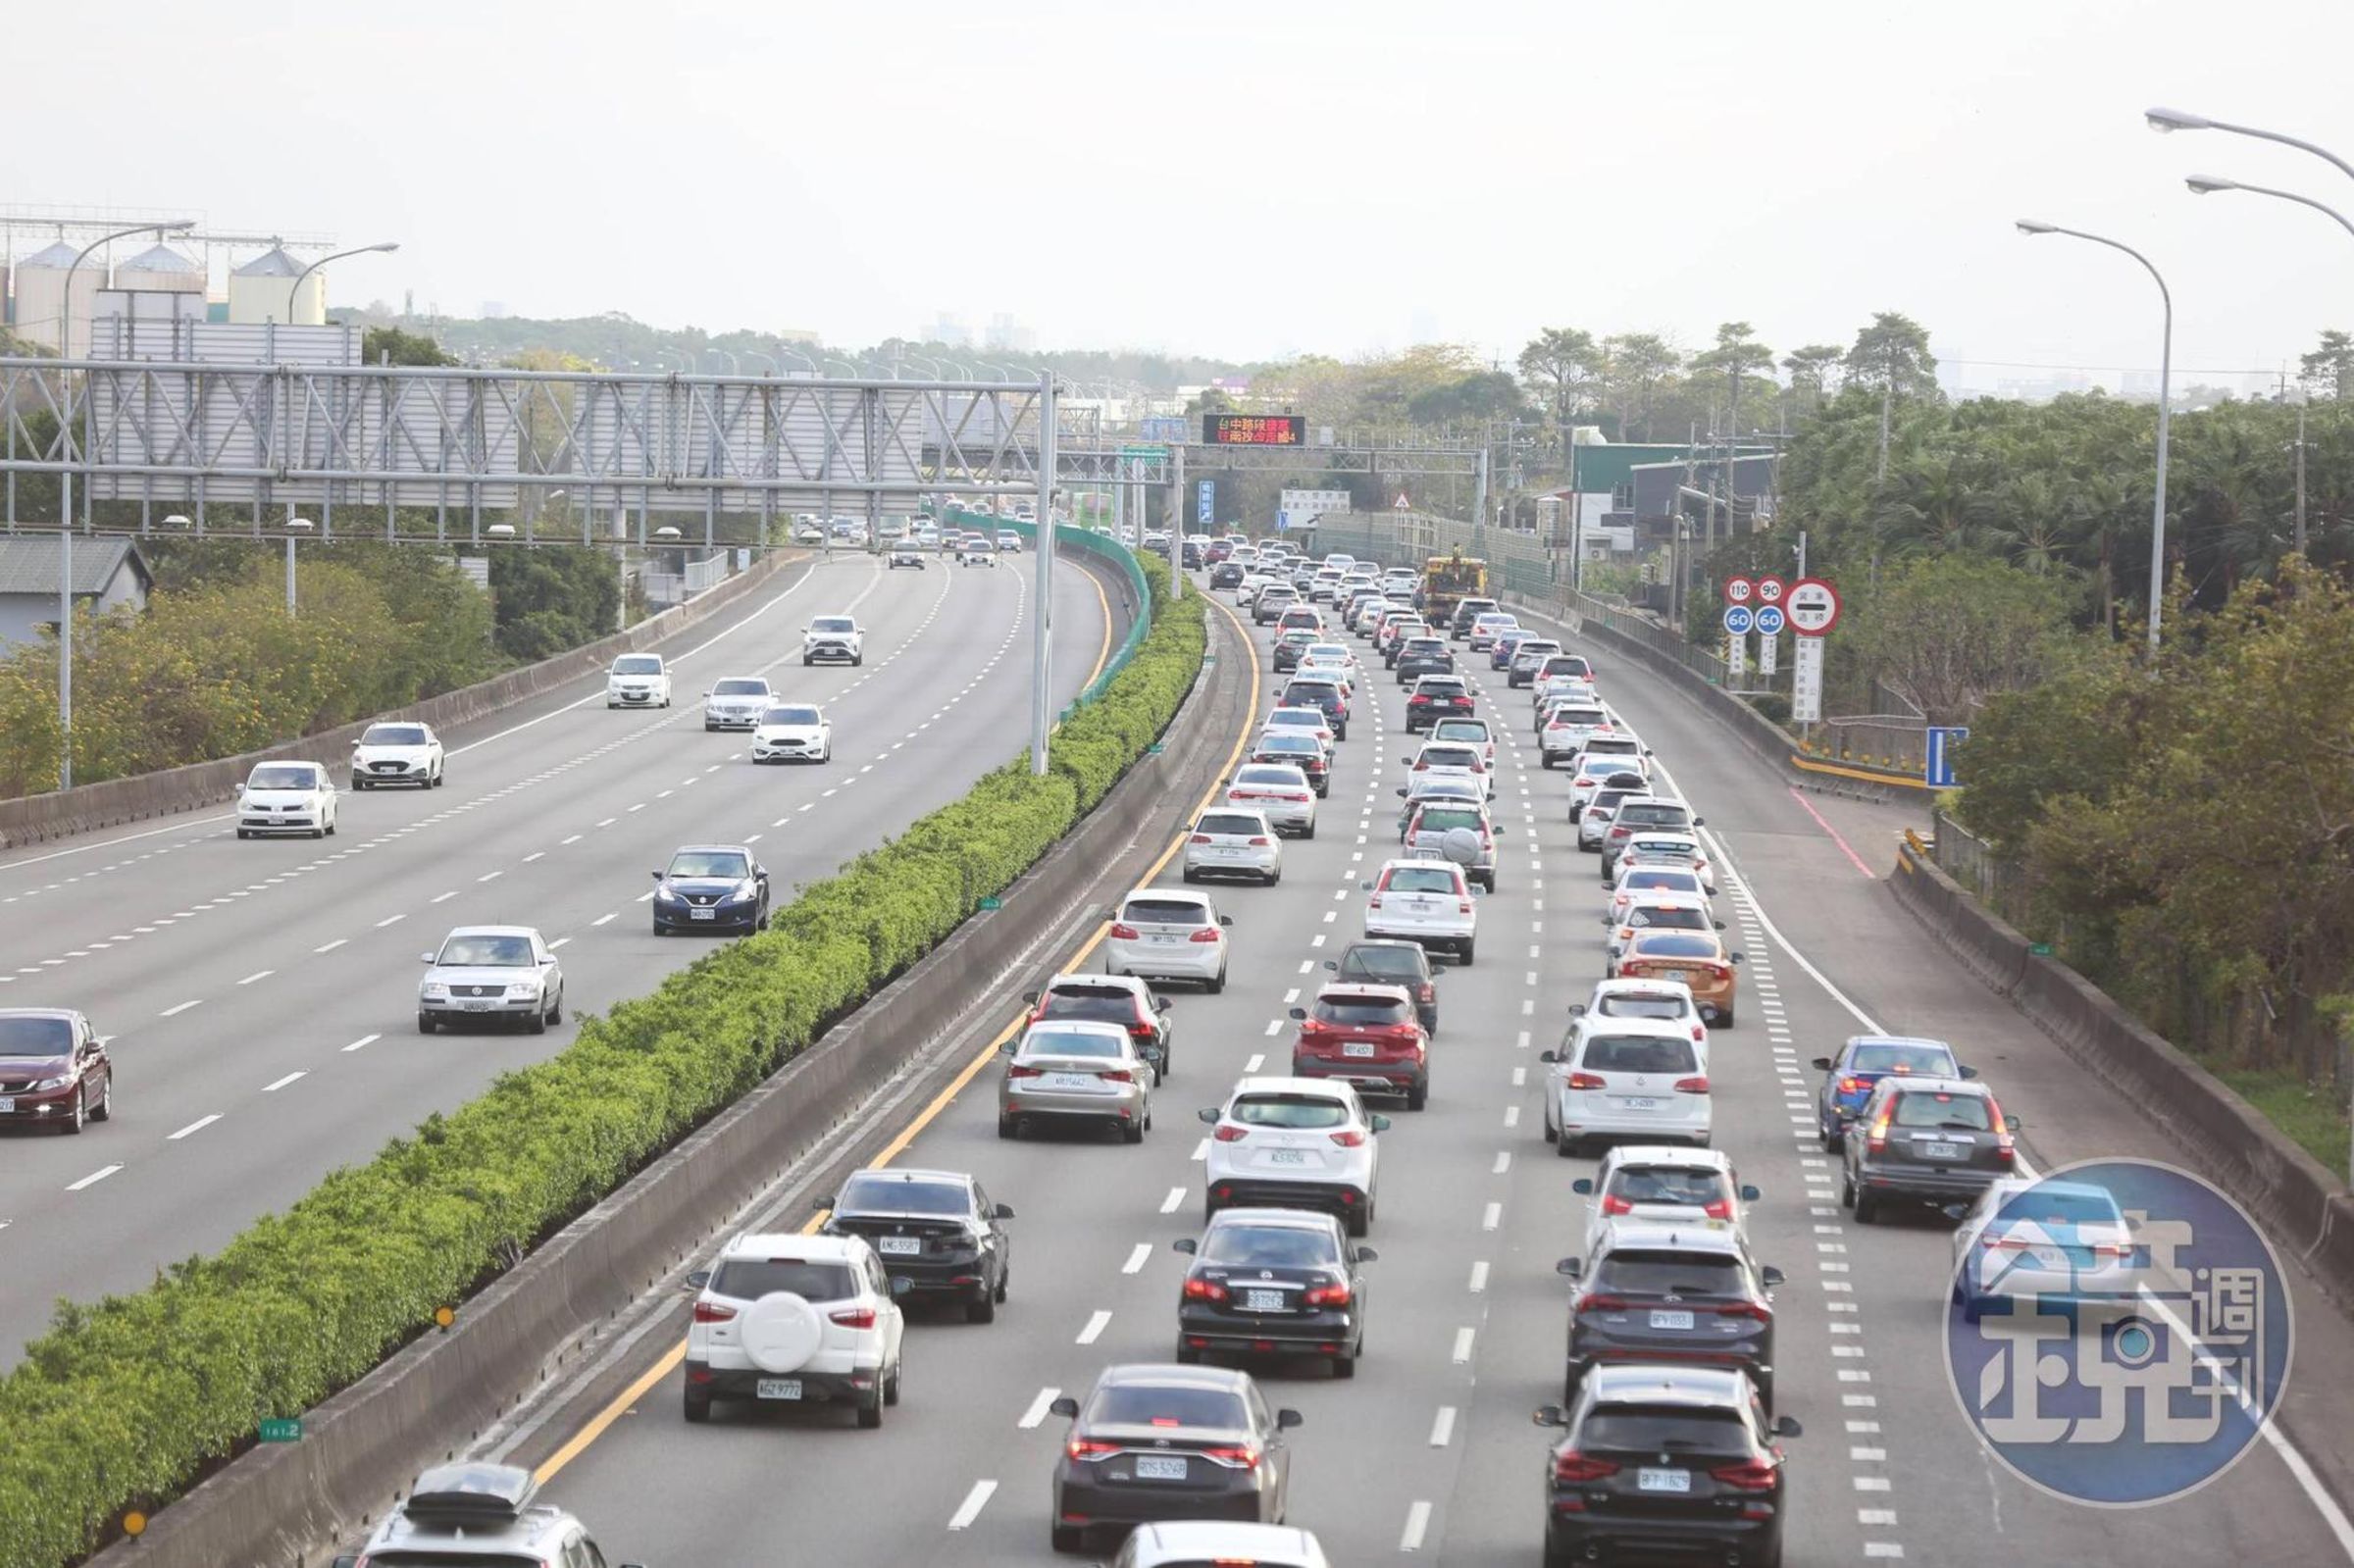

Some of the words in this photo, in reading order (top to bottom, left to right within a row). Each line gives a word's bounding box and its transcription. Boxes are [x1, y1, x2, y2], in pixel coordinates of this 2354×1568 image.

[1731, 585, 1748, 595] 110
[1763, 585, 1779, 595] 90
[1728, 614, 1748, 626] 60
[1760, 614, 1779, 626] 60
